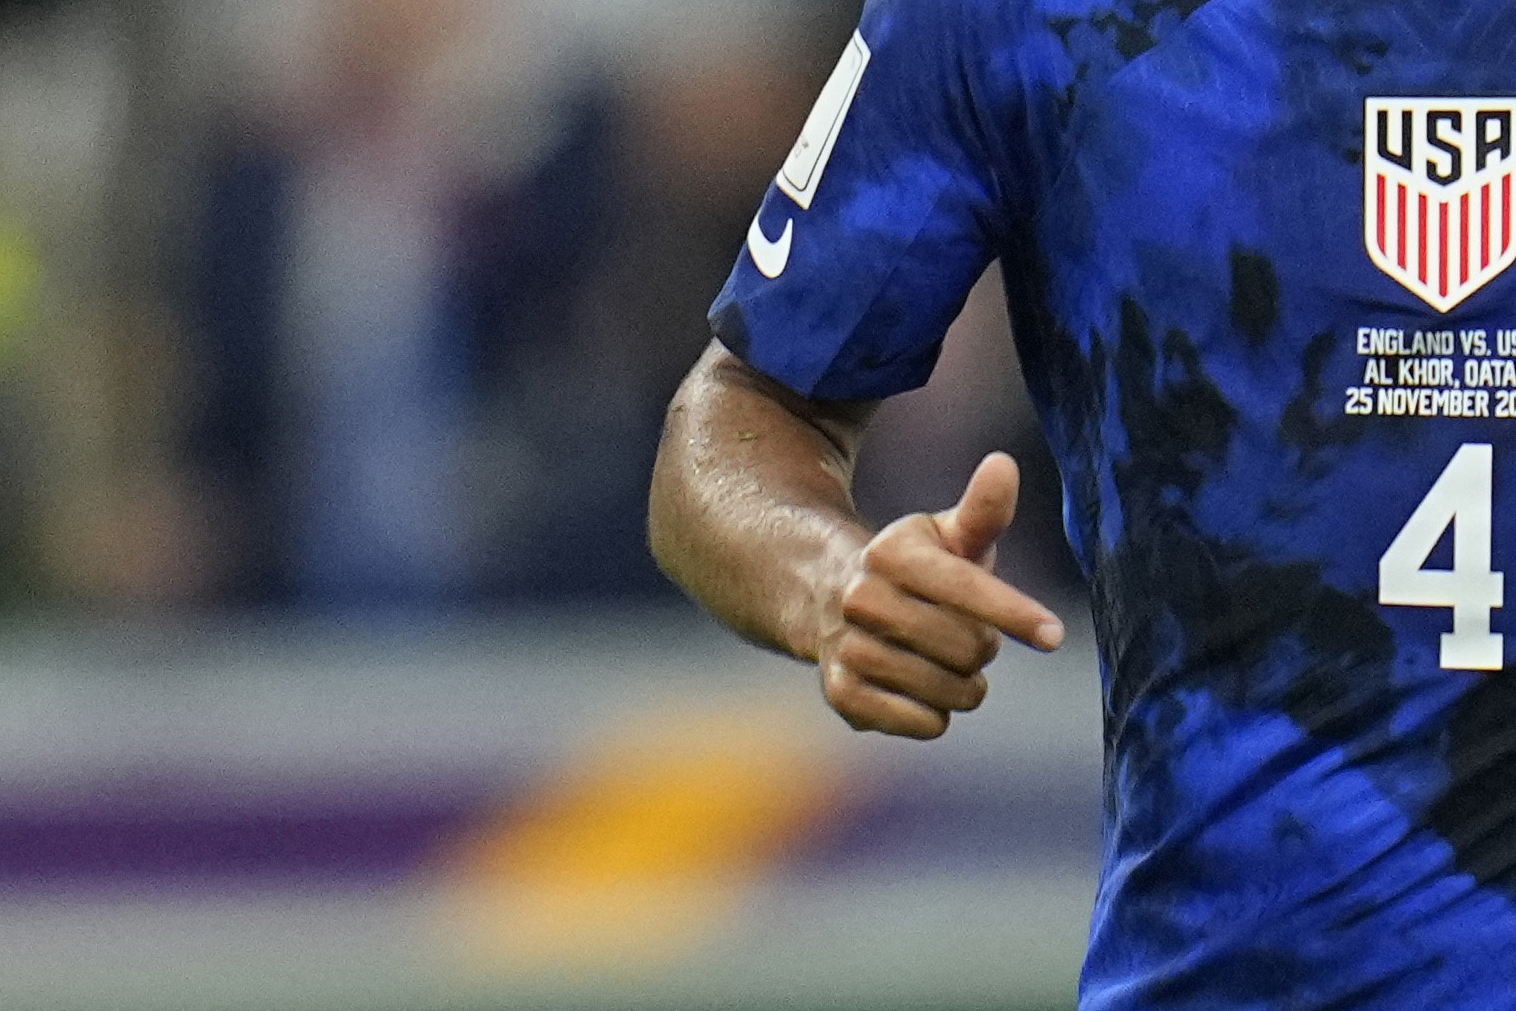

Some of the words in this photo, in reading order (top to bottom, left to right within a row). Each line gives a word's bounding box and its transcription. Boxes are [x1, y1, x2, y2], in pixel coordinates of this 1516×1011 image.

[1377, 110, 1511, 186] USA
[1357, 327, 1454, 355] ENGLAND
[1459, 330, 1492, 356] VS.
[1364, 358, 1393, 385] AL
[1398, 358, 1460, 389] KHOR,
[1345, 387, 1373, 414] 25
[1377, 388, 1489, 417] NOVEMBER
[1379, 443, 1504, 670] 4
